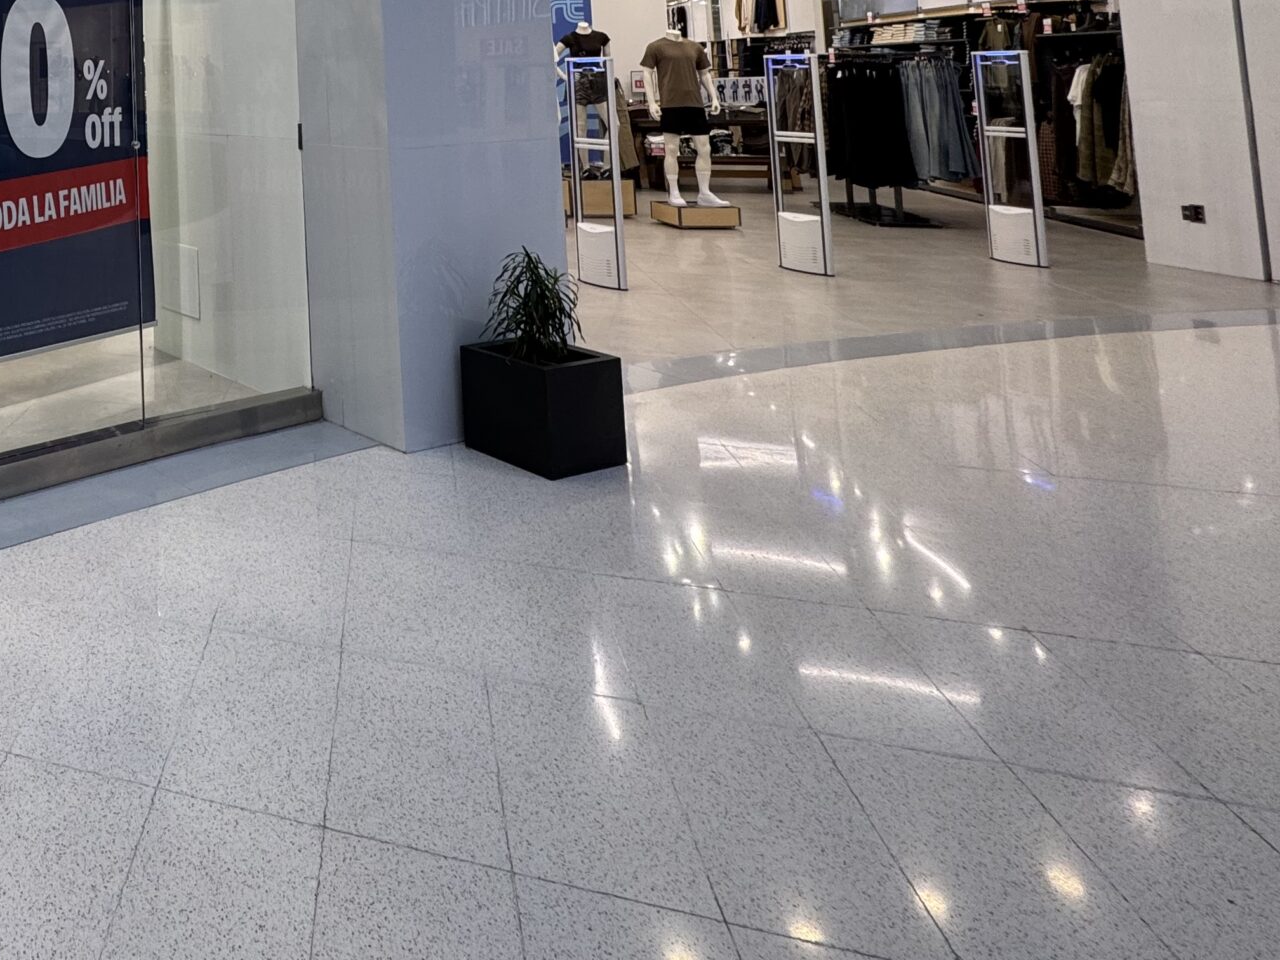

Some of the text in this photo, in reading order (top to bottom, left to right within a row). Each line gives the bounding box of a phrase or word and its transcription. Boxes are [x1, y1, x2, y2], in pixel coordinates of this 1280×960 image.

[83, 59, 108, 100] %
[85, 107, 123, 149] off
[32, 192, 57, 223] LA
[58, 178, 127, 218] FAMILIA
